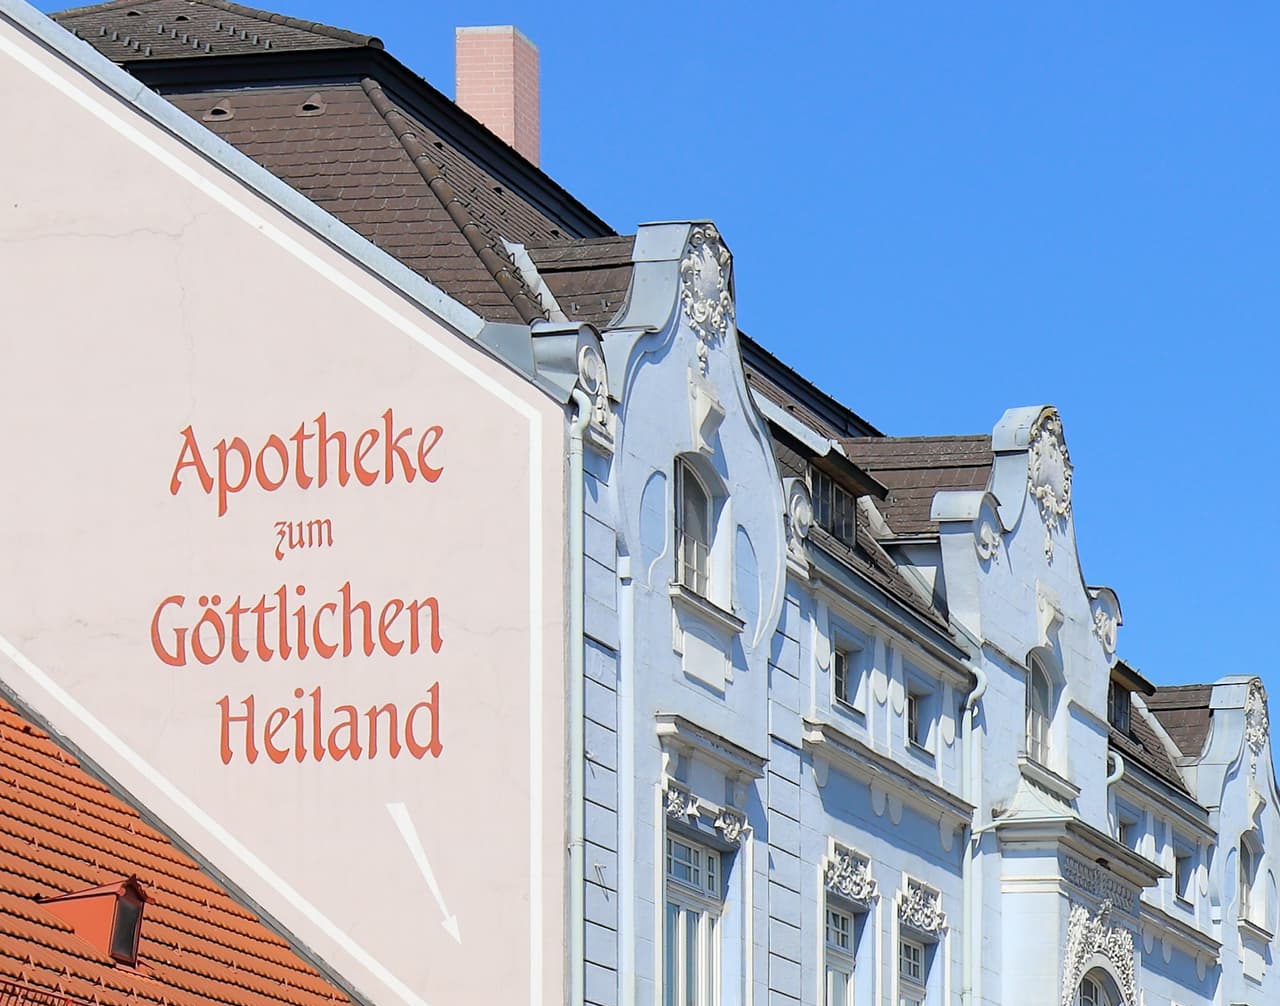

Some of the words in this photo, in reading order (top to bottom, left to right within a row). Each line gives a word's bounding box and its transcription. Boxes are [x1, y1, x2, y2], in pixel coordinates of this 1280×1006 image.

[169, 408, 445, 517] Apotheke
[273, 515, 334, 561] zum
[150, 581, 444, 667] Göttlichen
[216, 681, 443, 766] Heiland
